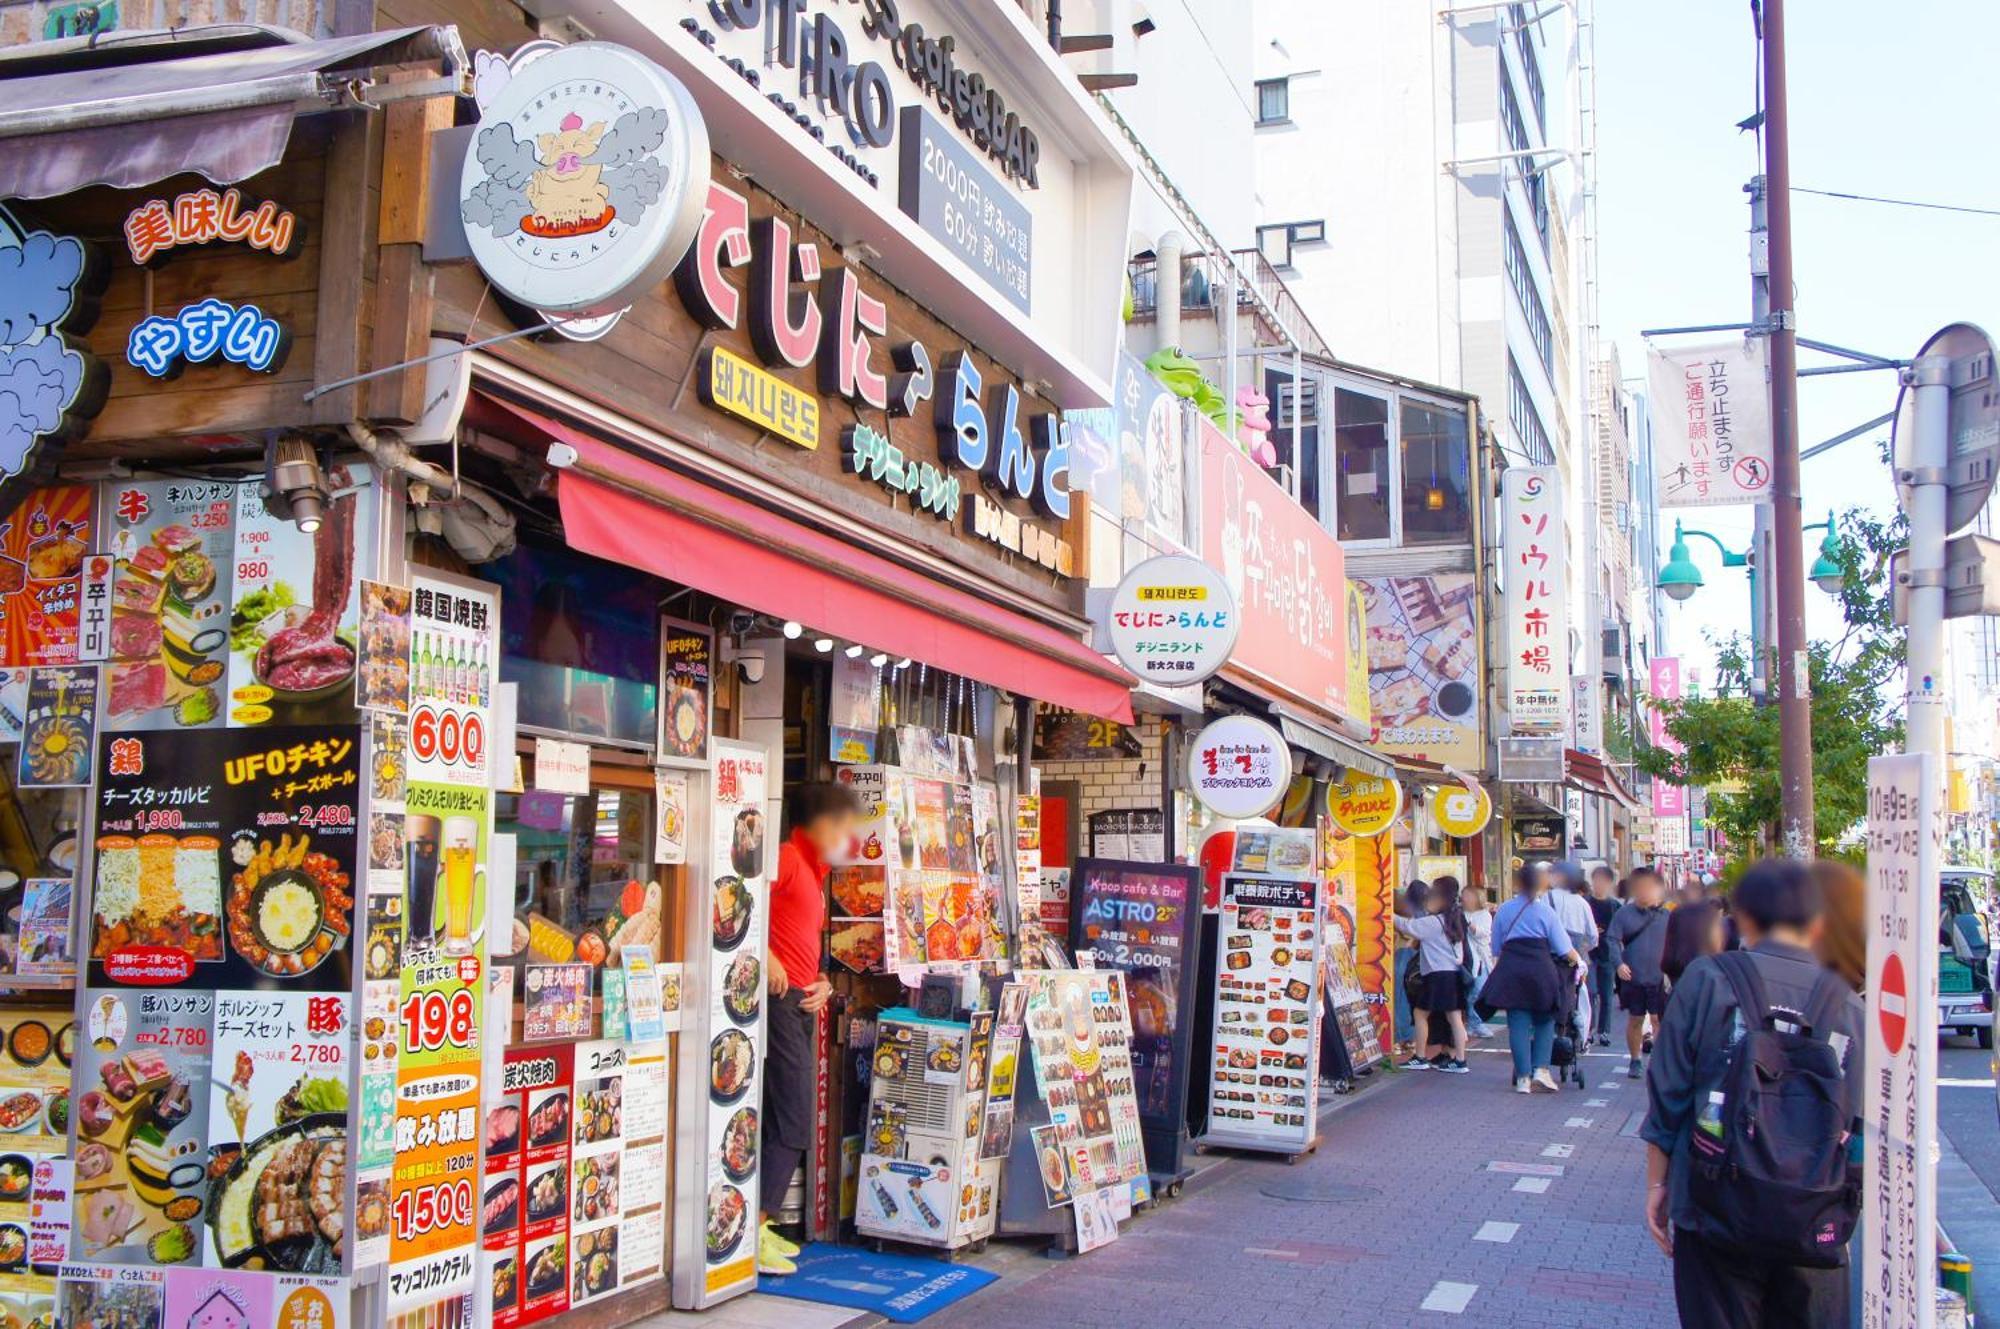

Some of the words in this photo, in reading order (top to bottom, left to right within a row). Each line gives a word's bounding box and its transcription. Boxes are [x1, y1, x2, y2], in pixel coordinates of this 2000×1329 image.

[925, 138, 980, 217] 2000円
[984, 196, 1028, 262] 飲み放題
[125, 189, 295, 264] 美味しい
[944, 202, 978, 256] 60分
[130, 299, 280, 375] やすい
[714, 353, 817, 443] 돼지니란도
[1685, 362, 1713, 497] ご通行願います
[1708, 360, 1734, 473] 立ち止まらず
[118, 490, 148, 522] 牛
[166, 484, 236, 502] 牛ハンサン
[191, 513, 229, 528] 3,250
[238, 562, 269, 579] 980
[36, 583, 77, 602] イイダコ
[1518, 510, 1553, 675] ソウル市場
[86, 583, 106, 655] 쭈꾸미
[414, 587, 488, 632] 韓国焼酎
[1135, 642, 1204, 654] デジニランド
[1147, 660, 1195, 671] 新大久保店
[1515, 695, 1559, 706] 年中無休
[1088, 721, 1119, 748] 2F
[111, 737, 143, 776] 鶏
[225, 738, 353, 785] UFOチキン
[103, 787, 211, 805] チーズタッカルビ
[1868, 785, 1908, 821] 10月9日
[1868, 829, 1919, 858] スポーツの日
[1090, 878, 1121, 893] K-pop
[1122, 882, 1148, 895] cafe
[1150, 886, 1159, 896] &
[1162, 885, 1184, 898] Bar
[1879, 868, 1909, 894] 11:30
[1087, 898, 1156, 922] ASTRO
[1880, 914, 1909, 942] 15:00
[1115, 945, 1172, 968] 2,000円
[140, 994, 213, 1014] 豚ハンサン
[307, 996, 343, 1034] 豚
[218, 1020, 297, 1040] チーズセット
[591, 1048, 628, 1070] コース
[504, 1060, 555, 1089] 炭火焼肉
[395, 1106, 476, 1153] 飲み放題
[446, 1154, 475, 1173] 120分
[391, 1254, 472, 1294] マッコリカクテル
